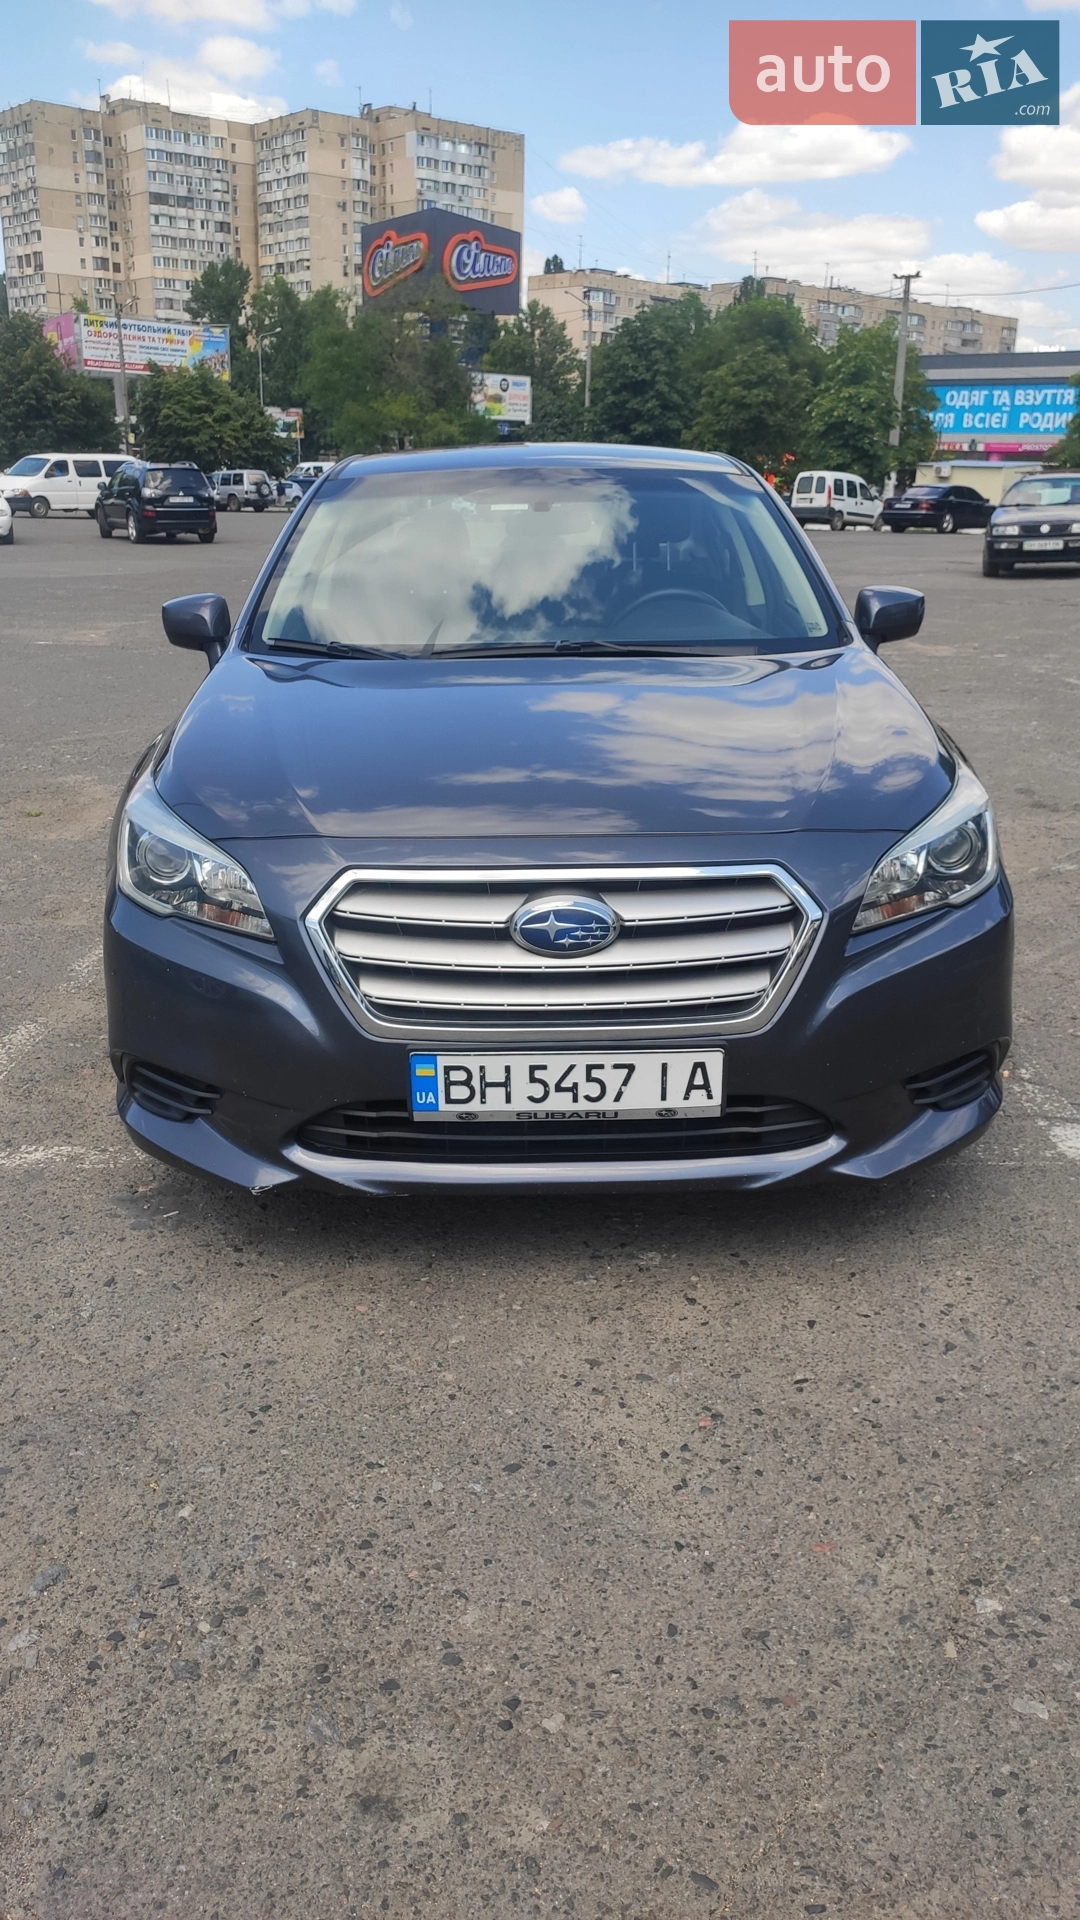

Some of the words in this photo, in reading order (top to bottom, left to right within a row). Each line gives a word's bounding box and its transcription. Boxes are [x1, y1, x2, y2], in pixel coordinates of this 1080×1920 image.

[451, 240, 514, 281] Сільпо
[87, 330, 146, 343] ОЗДОРОЛЕННЯ
[121, 322, 171, 336] ФУТБОЛЬНИЙ
[174, 328, 192, 337] ТАБІР
[945, 390, 990, 410] ОДЯГ
[992, 389, 1011, 406] ТА
[1014, 388, 1075, 406] ВЗУТТЯ
[928, 412, 955, 429] ЛЯ
[962, 406, 1010, 429] ВСІЄЇ
[443, 1064, 512, 1105] BH
[526, 1063, 636, 1104] 5457
[416, 1092, 436, 1104] UA
[515, 1111, 619, 1121] SUBARU
